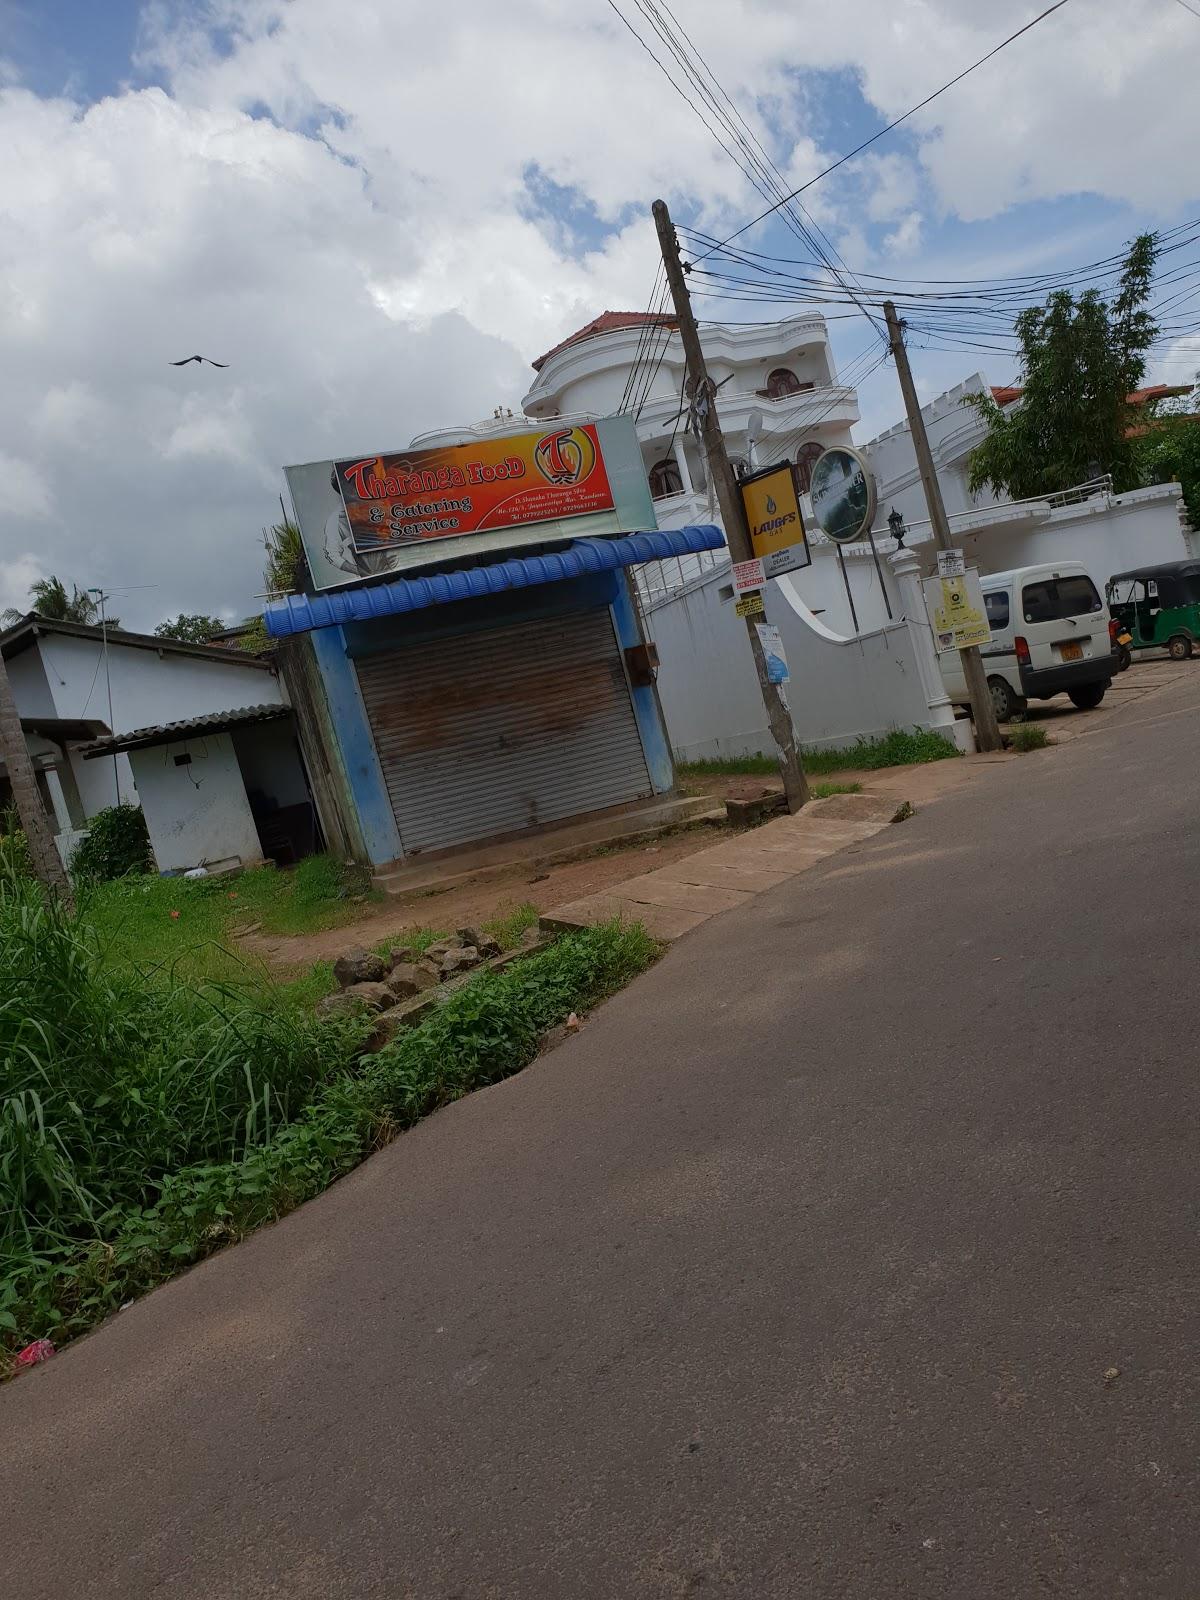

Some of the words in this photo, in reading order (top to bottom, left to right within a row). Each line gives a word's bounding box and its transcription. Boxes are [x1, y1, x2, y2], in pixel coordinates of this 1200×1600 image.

[344, 458, 466, 499] Tharanga
[369, 506, 384, 523] &
[390, 496, 472, 520] Catering
[389, 515, 460, 538] Service
[753, 511, 796, 537] LAUGFS
